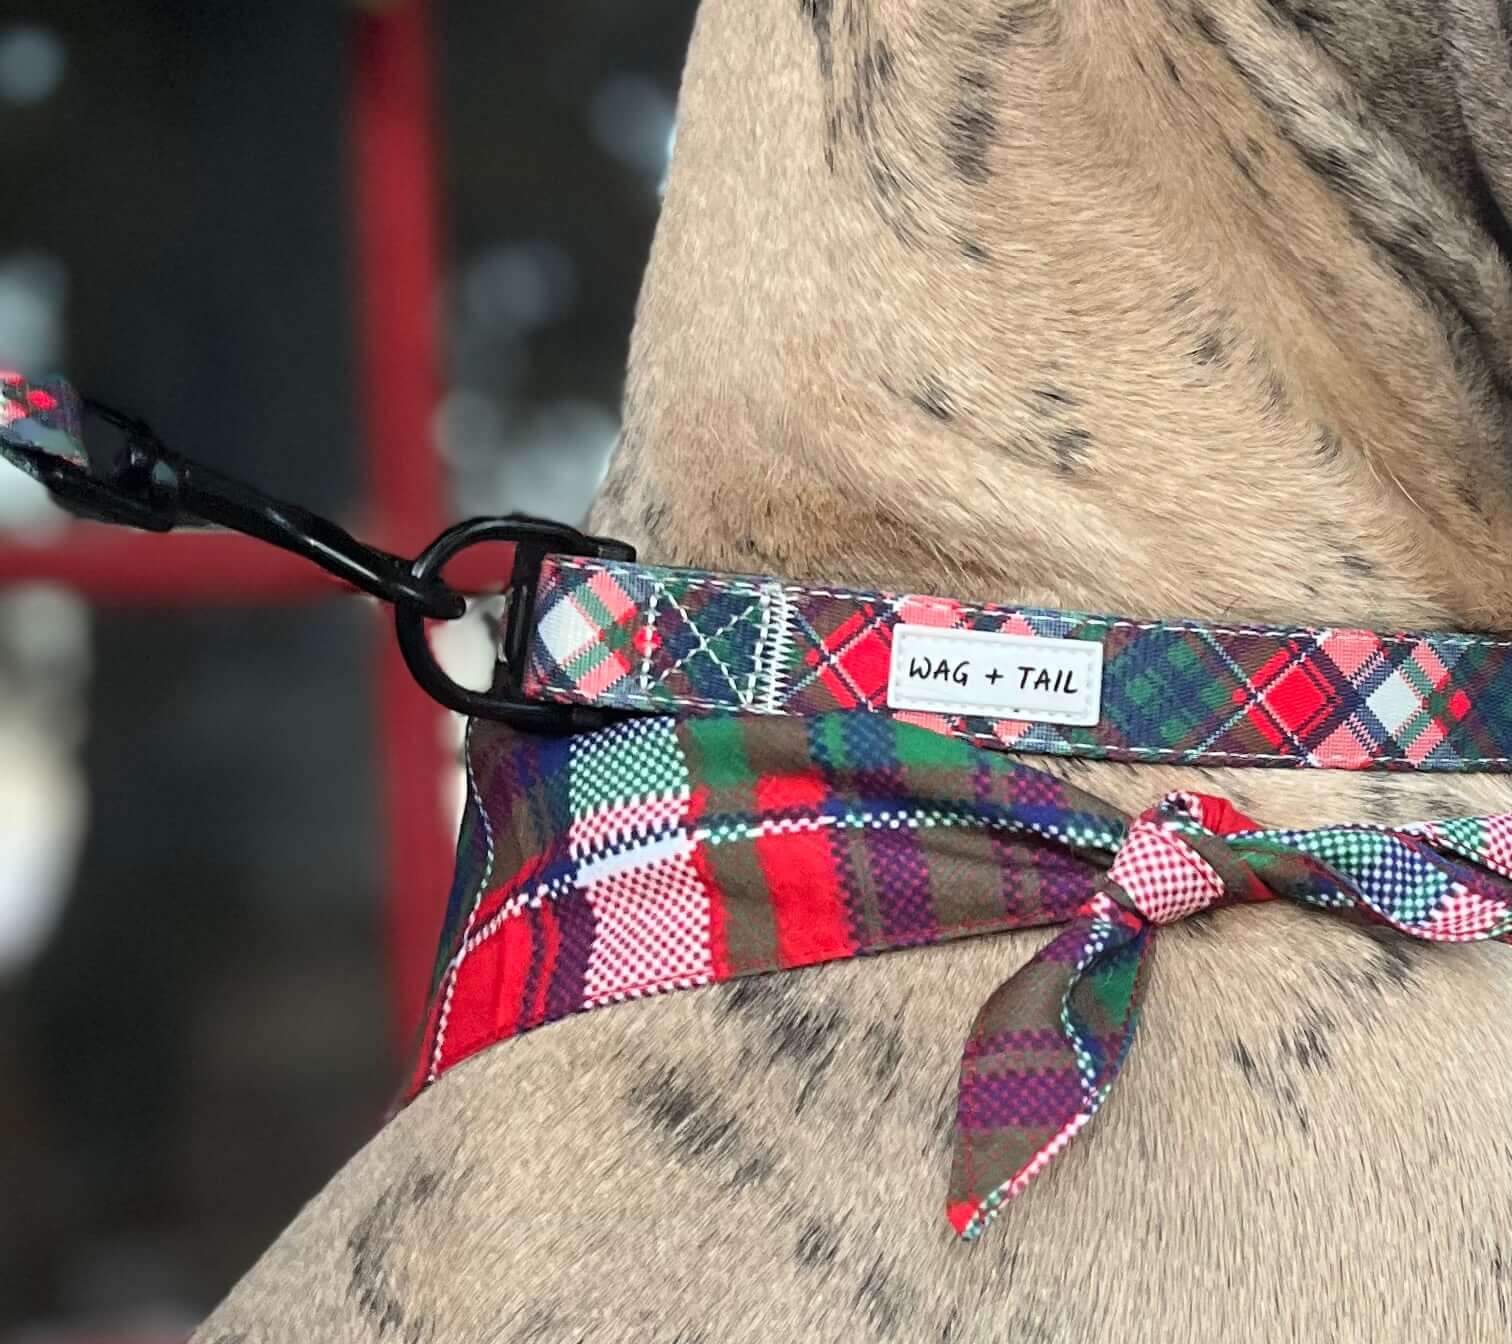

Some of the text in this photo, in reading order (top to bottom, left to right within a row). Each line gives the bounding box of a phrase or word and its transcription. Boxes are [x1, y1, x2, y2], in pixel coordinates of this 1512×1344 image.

[909, 656, 1078, 694] WAG + TAIL
